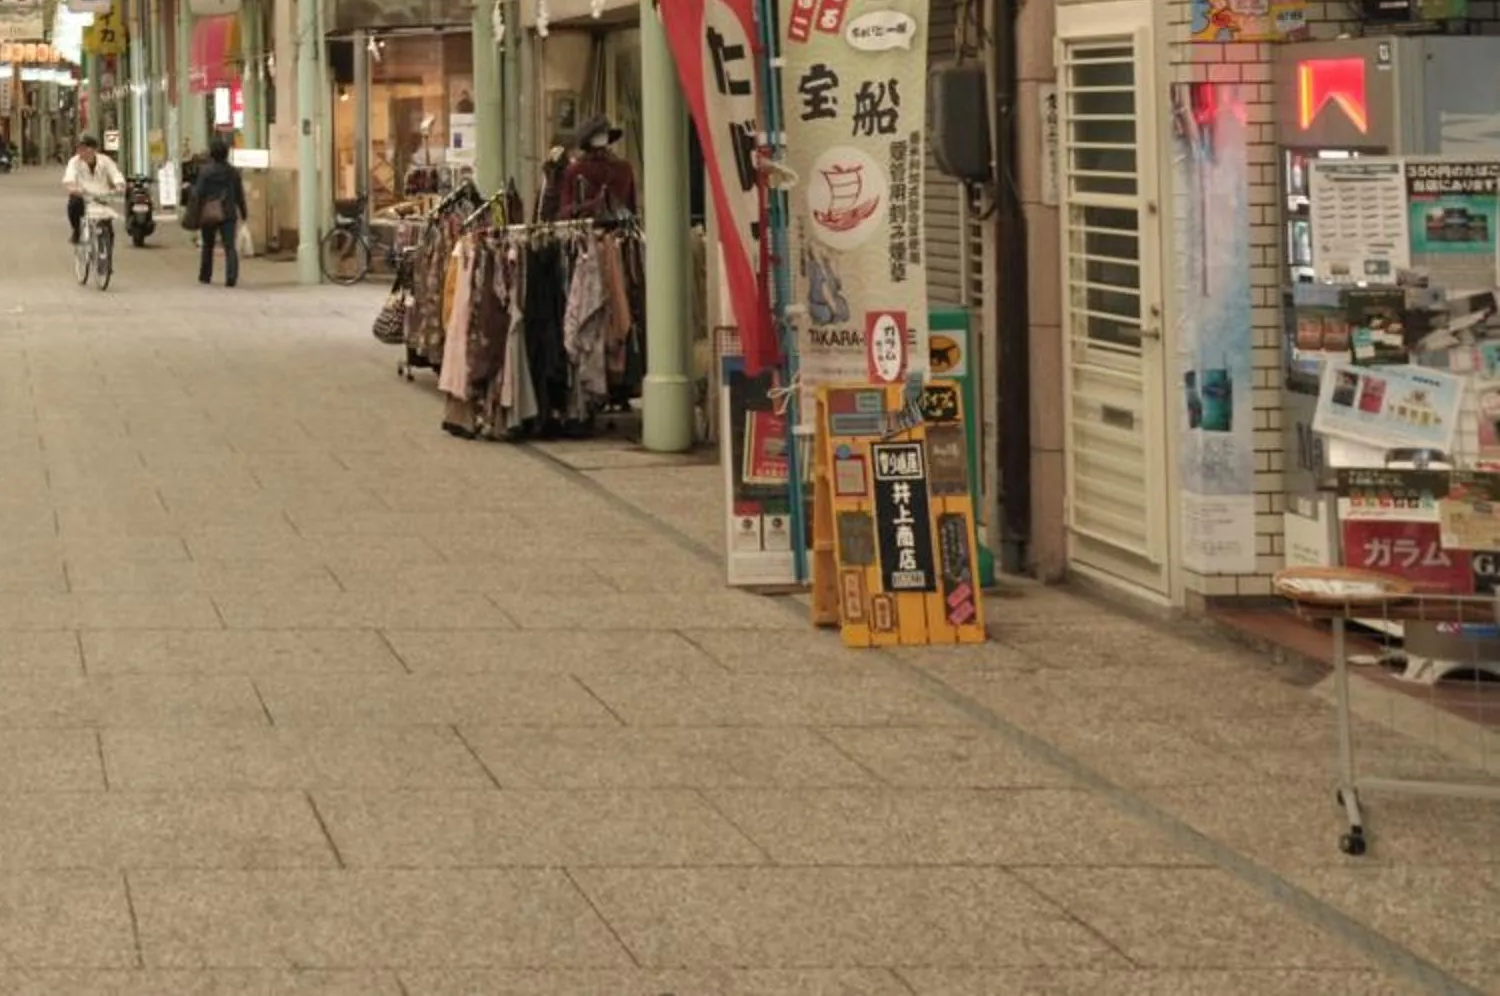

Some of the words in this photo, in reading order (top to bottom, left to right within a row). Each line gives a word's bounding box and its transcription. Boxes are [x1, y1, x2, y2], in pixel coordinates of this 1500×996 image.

[798, 63, 901, 137] 宝船
[891, 481, 918, 571] 井上商店
[1363, 538, 1452, 568] ガラム
